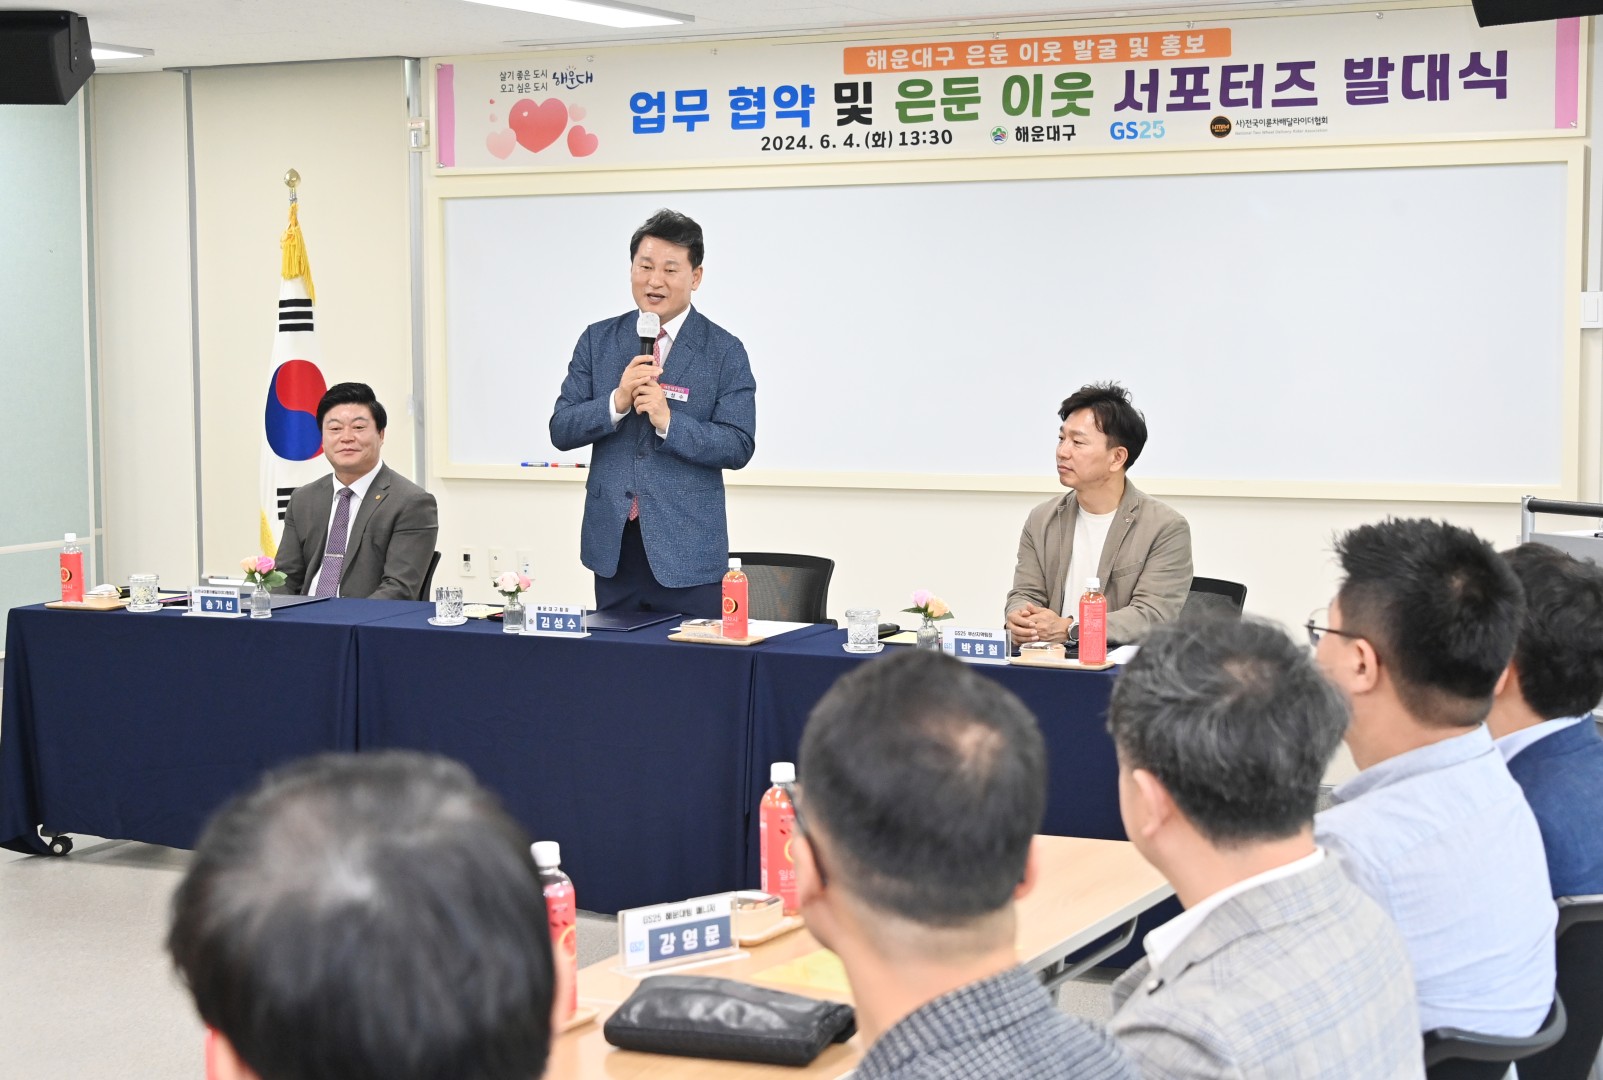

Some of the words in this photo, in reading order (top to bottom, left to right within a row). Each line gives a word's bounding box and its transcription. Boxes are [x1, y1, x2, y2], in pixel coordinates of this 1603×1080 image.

[866, 46, 955, 70] 해운대구
[965, 44, 1009, 65] 은둔
[1018, 41, 1063, 62] 이웃
[1072, 38, 1120, 60] 발굴
[1128, 36, 1149, 58] 및
[1160, 34, 1206, 57] 홍보
[500, 71, 515, 82] 살기
[517, 69, 531, 81] 좋은
[533, 69, 548, 79] 도시
[552, 67, 593, 89] 해운대
[500, 83, 515, 93] 오고
[517, 82, 531, 94] 싶은
[533, 82, 548, 92] 도시
[629, 89, 710, 135] 업무
[728, 84, 816, 130] 협약
[833, 81, 873, 127] 및
[895, 76, 982, 124] 은둔
[1001, 71, 1095, 118] 이웃
[1113, 60, 1319, 114] 서포터즈
[1343, 50, 1508, 106] 발대식
[760, 135, 814, 152] 2024.
[819, 133, 838, 149] 6.
[898, 129, 953, 147] 13:30
[1014, 124, 1077, 143] 해운대구
[1110, 120, 1166, 141] GS25
[540, 616, 577, 630] 김성수
[961, 642, 998, 656] 박현철
[643, 914, 662, 924] GS25
[659, 924, 720, 956] 강영문
